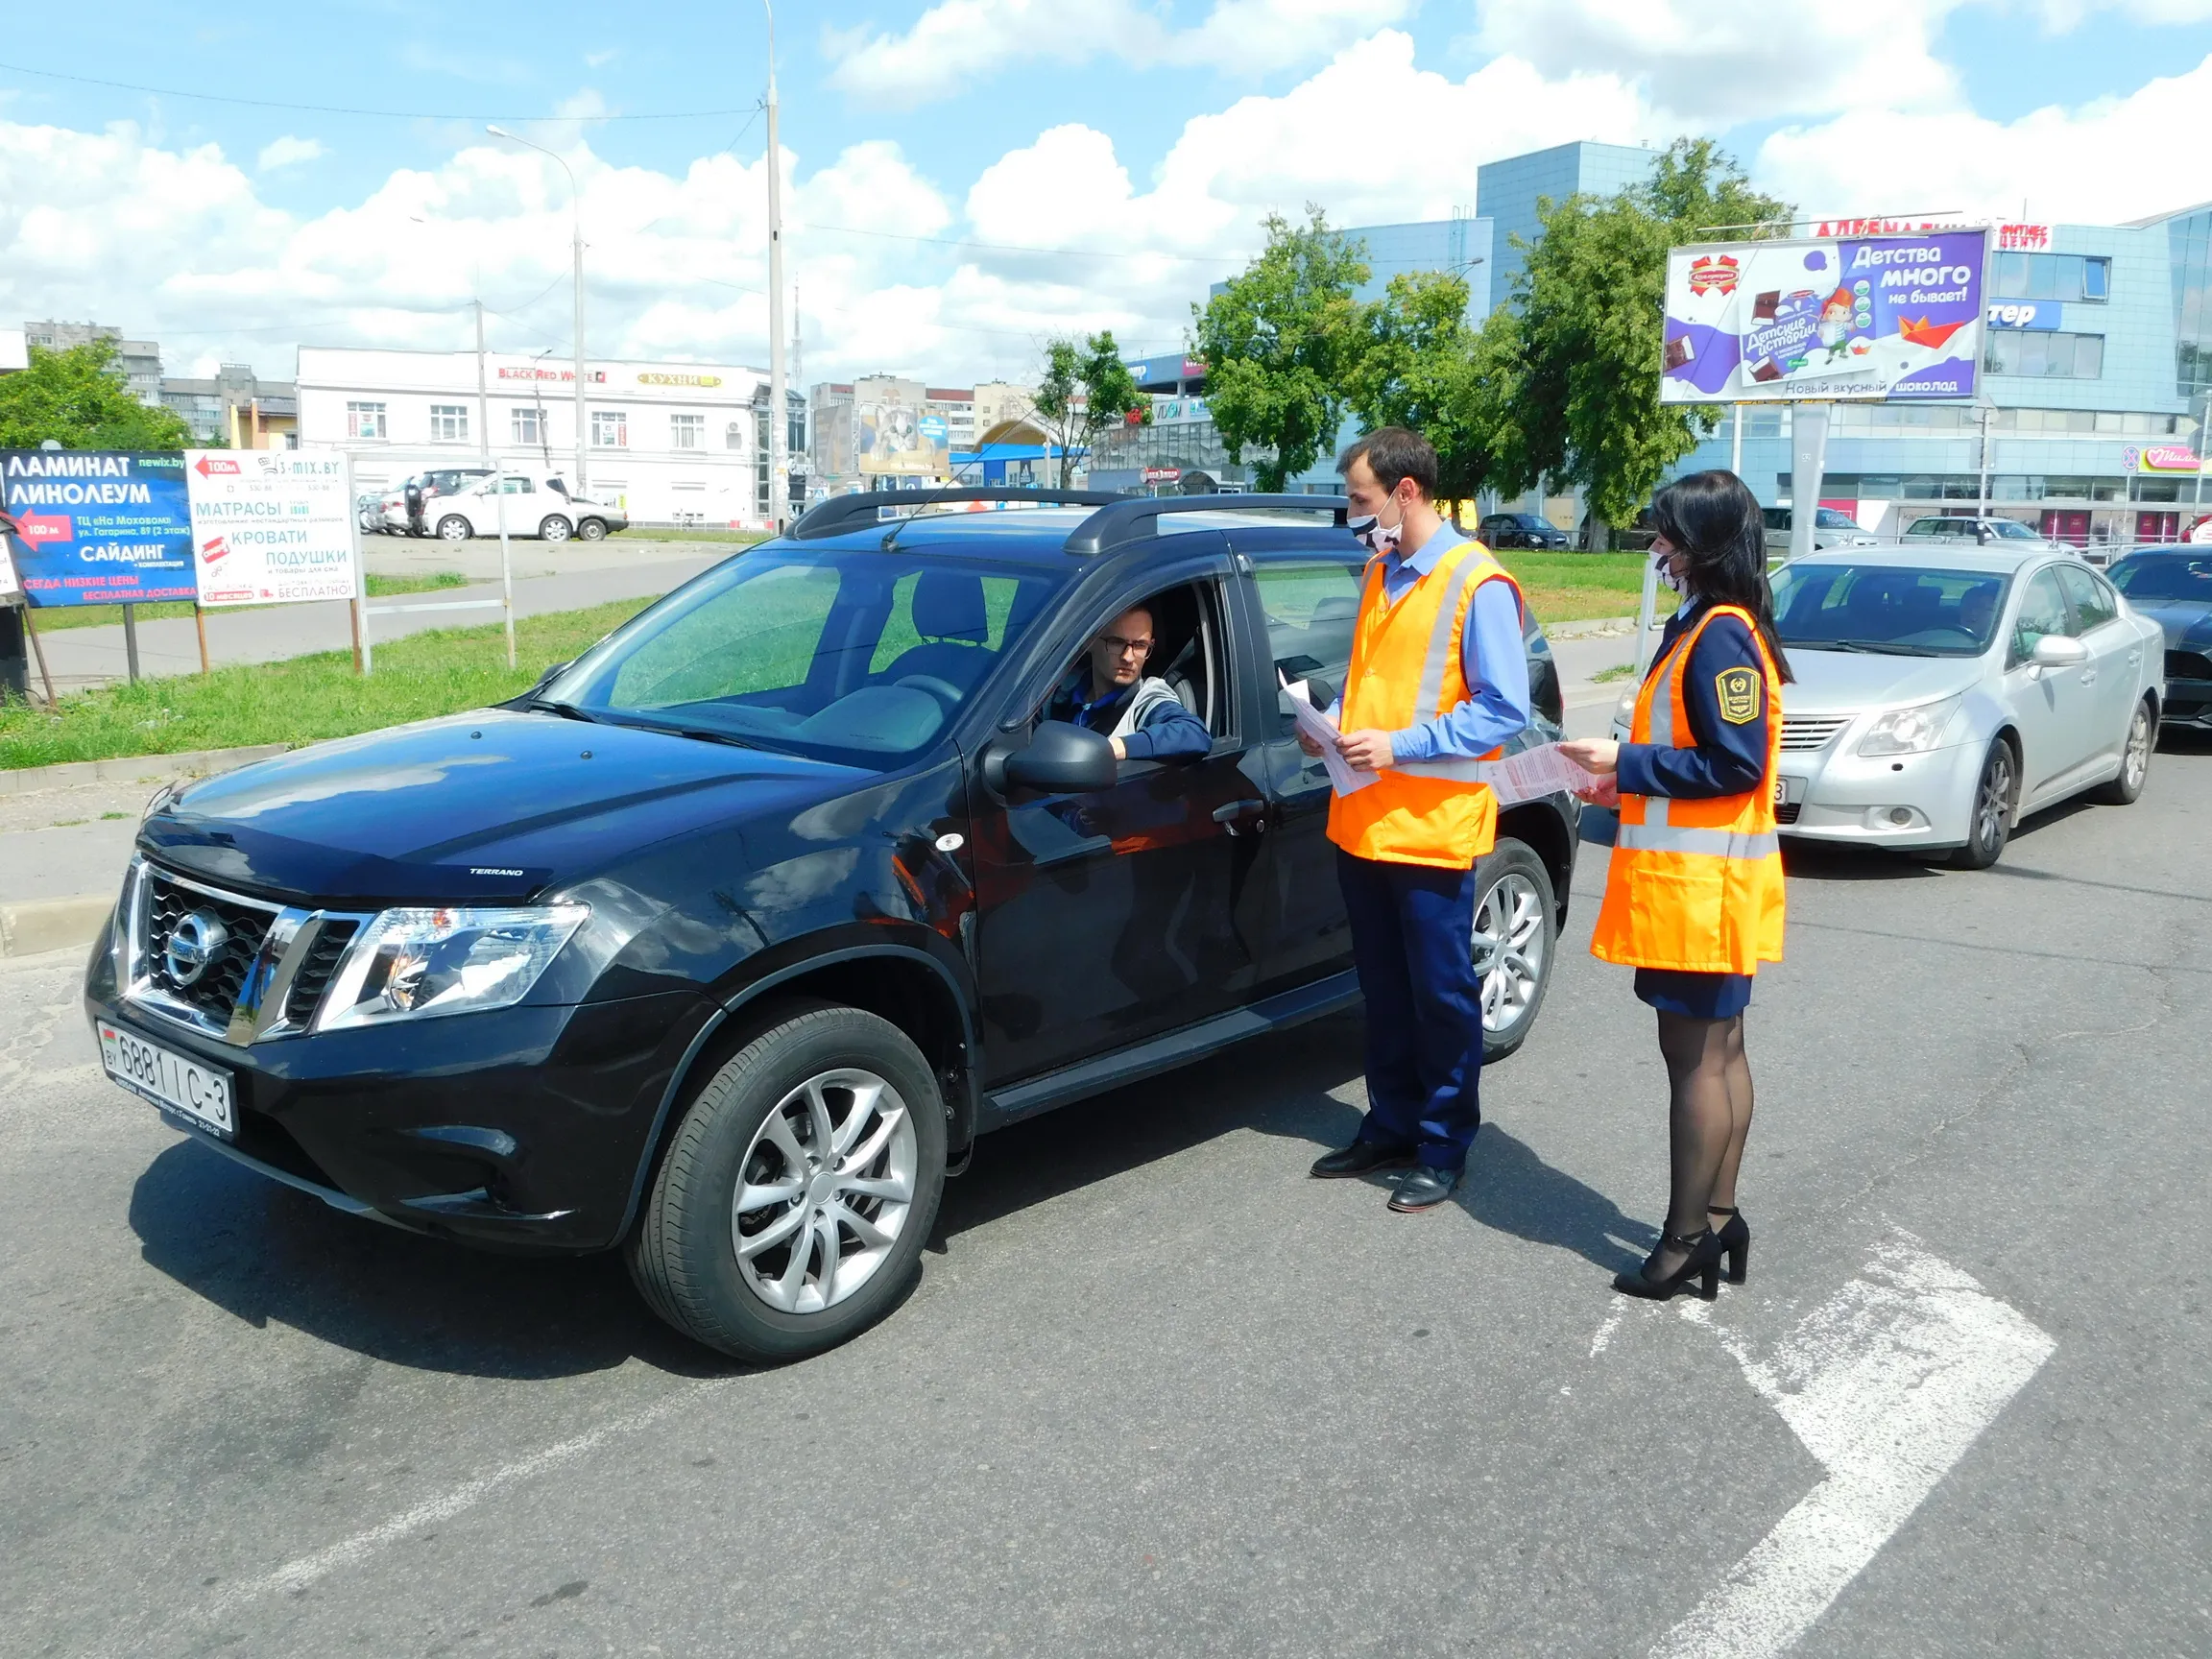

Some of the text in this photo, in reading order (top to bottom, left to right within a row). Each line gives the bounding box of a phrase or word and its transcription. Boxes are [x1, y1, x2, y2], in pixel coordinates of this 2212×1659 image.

[1816, 219, 1965, 237] АДРЕНА
[2000, 224, 2048, 236] ФИТНЕС
[1999, 237, 2048, 250] ЦЕНТР
[1852, 246, 1941, 269] Детства
[1881, 266, 1971, 288] много
[1888, 287, 1967, 304] не бывает!
[1988, 305, 2035, 327] тер
[1746, 318, 1807, 353] Детские
[1758, 323, 1817, 356] истории
[561, 371, 593, 382] WHTE
[647, 373, 699, 385] КУХНИ
[1786, 380, 1958, 395] Новый вкусный шоколад
[8, 456, 131, 477] ЛАМИНАТ
[138, 457, 185, 469] newix.by
[11, 483, 152, 505] ЛИНОЛЕУМ
[196, 502, 281, 517] МАТРАСЫ
[76, 517, 92, 527] ТЦ
[29, 525, 48, 535] 100
[231, 530, 308, 545] КРОВАТИ
[80, 541, 165, 564] САЙДИНГ
[266, 550, 348, 566] ПОДУШКИ
[23, 576, 139, 589] СЕГДА НИЗКИЕ ЦЕНЫ
[83, 587, 197, 600] БЕСПЛАТНАЯ ДОСТАВКА
[278, 586, 351, 598] БЕСПЛАТНО!
[1773, 783, 1783, 801] 3
[469, 868, 524, 877] TERRANO
[107, 1049, 117, 1068] BY
